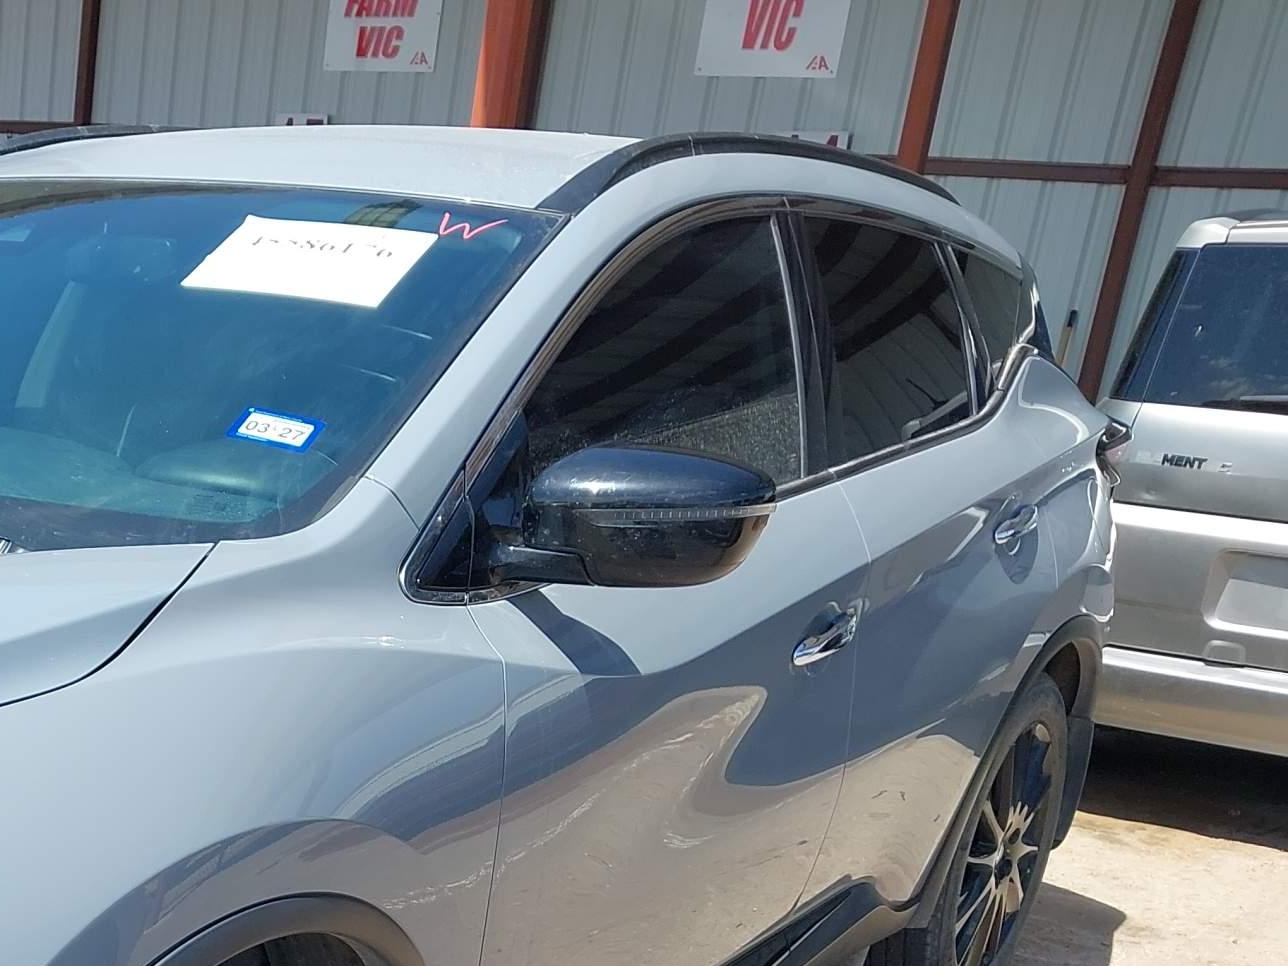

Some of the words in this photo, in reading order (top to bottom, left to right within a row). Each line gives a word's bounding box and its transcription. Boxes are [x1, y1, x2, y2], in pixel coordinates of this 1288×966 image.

[344, 0, 419, 17] FARM
[742, 0, 805, 50] VIC
[355, 25, 405, 59] VIC
[245, 420, 270, 434] 03
[278, 427, 305, 441] 27
[1161, 453, 1209, 470] MENT
